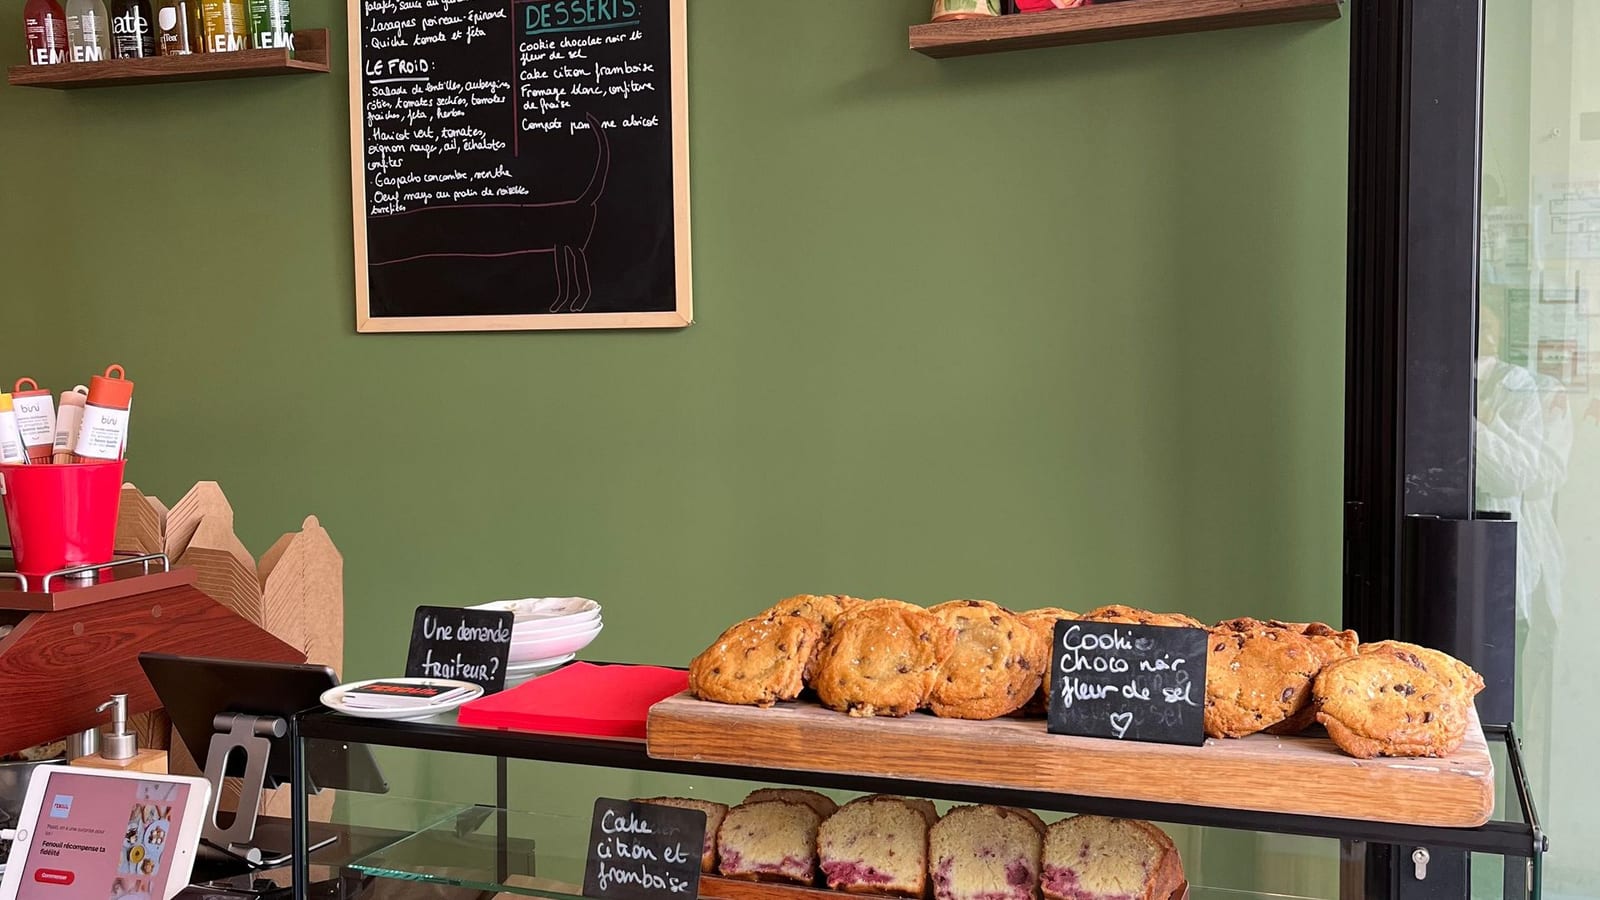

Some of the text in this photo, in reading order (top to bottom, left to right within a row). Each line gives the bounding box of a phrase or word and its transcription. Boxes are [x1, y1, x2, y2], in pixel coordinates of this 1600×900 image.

[111, 10, 148, 34] ate
[370, 18, 416, 38] Lasagnes
[371, 37, 408, 49] Quiche
[413, 31, 447, 46] tomate
[451, 31, 462, 40] et
[520, 30, 643, 52] Cookie chocolat noir et
[29, 48, 69, 66] LEM
[70, 45, 108, 63] LEM
[520, 48, 587, 67] fleur de sel
[366, 59, 383, 75] LE
[520, 61, 655, 84] Cake citron framboise
[372, 86, 408, 97] Salade
[412, 84, 424, 95] de
[521, 80, 655, 101] Fromage blanc, confiture
[395, 96, 433, 109] tomates
[471, 93, 506, 105] tomates
[523, 98, 571, 115] de fraise
[437, 107, 465, 119] herbes
[373, 126, 410, 141] Haricot
[441, 125, 486, 140] tomates,
[522, 117, 562, 133] Compote
[622, 114, 659, 127] abricot
[367, 143, 405, 157] oignon
[463, 138, 506, 151] échalotes
[367, 156, 403, 173] confites
[375, 172, 421, 188] Gaspacho
[474, 164, 513, 180] menthe
[374, 190, 399, 206] Oeuf
[436, 191, 450, 199] au
[453, 188, 477, 201] pralin
[481, 186, 494, 197] de
[424, 616, 510, 642] Une demande
[1060, 650, 1185, 673] choco noir
[1061, 676, 1198, 708] fleur de sel
[601, 809, 652, 834] Cake
[42, 840, 63, 849] Fenouil
[63, 841, 98, 853] récompense
[597, 837, 689, 863] citron et
[598, 862, 689, 892] framboise
